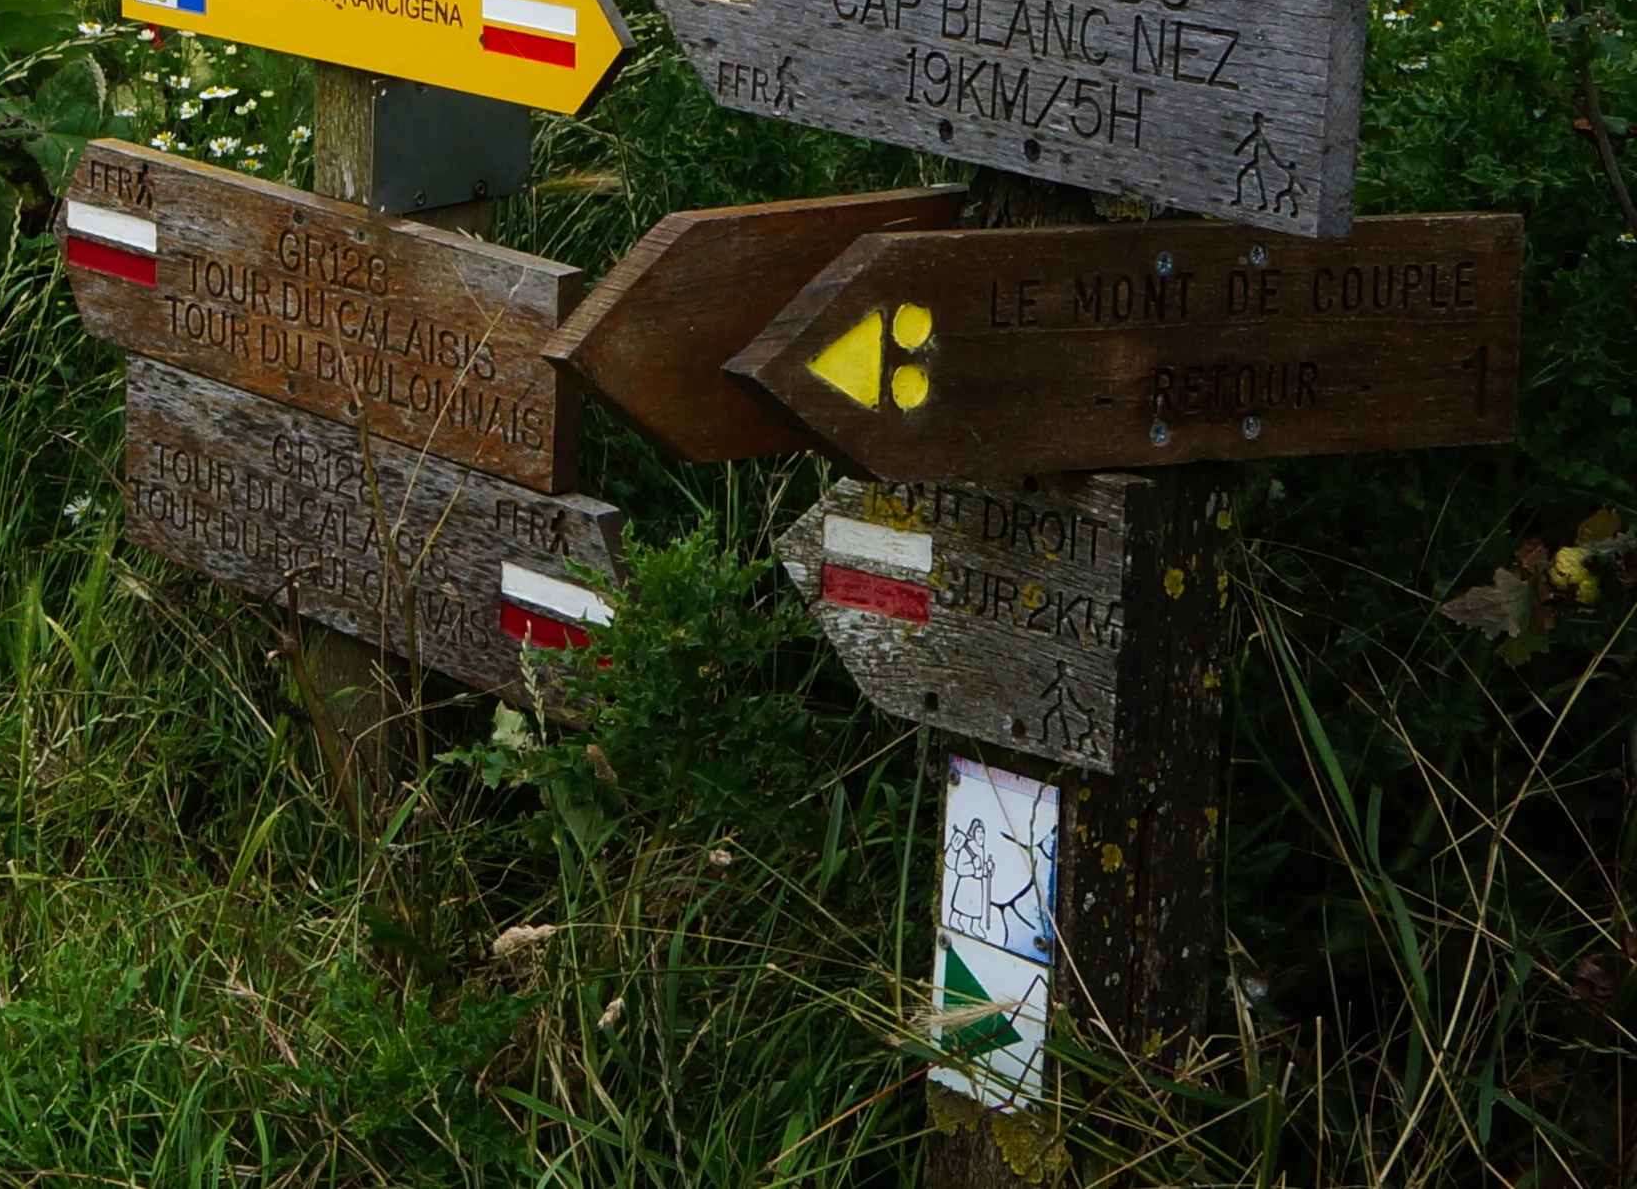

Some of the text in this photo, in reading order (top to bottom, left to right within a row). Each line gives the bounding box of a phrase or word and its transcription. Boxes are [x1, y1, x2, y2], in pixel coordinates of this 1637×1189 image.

[1132, 14, 1240, 91] NEZ
[903, 47, 1145, 149] 19KM/5H
[277, 228, 389, 296] GR128
[989, 260, 1477, 328] LE MONT DE COUPLE
[187, 255, 497, 382] TOUR DU CALAISIS
[163, 294, 544, 451] TOUR DU BOULONNAIS
[1150, 361, 1322, 414] RETOUR
[272, 433, 380, 505] GR128
[127, 474, 212, 546] TOUR
[221, 510, 261, 559] DU
[152, 439, 449, 584] TOUR DU CALASIS
[983, 495, 1109, 567] DROIT
